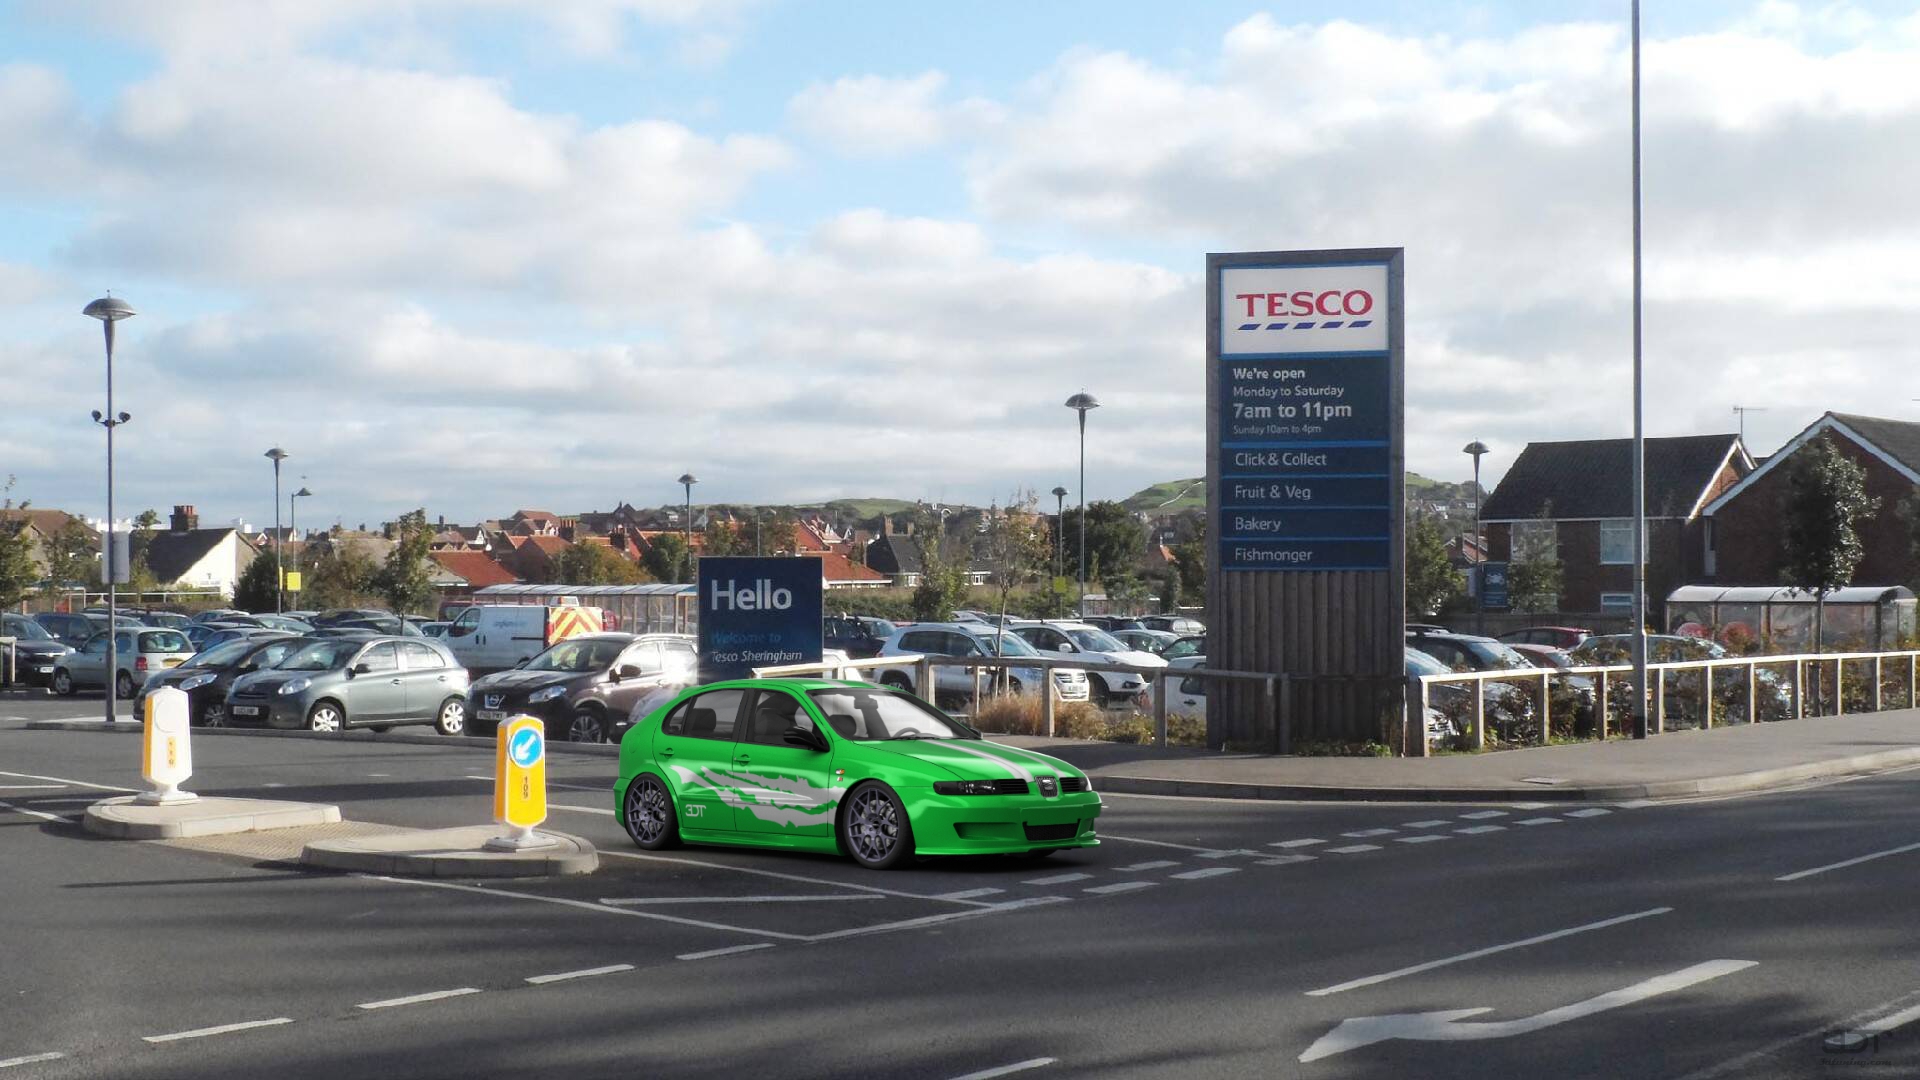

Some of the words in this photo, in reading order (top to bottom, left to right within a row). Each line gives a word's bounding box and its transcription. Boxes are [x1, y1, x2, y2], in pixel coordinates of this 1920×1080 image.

[1236, 290, 1373, 317] TESCO
[1233, 367, 1268, 379] We're
[1273, 368, 1306, 382] open
[1233, 386, 1278, 398] Monday
[1280, 387, 1291, 396] to
[1294, 384, 1344, 397] Saturday
[1233, 403, 1271, 419] 7am
[1278, 404, 1296, 418] to
[1302, 402, 1352, 421] 11pm
[1233, 424, 1264, 435] Sunday
[1266, 424, 1290, 434] 10am
[1291, 425, 1300, 433] to
[1302, 425, 1322, 435] 4pm
[1235, 452, 1266, 466] Click
[1268, 453, 1279, 466] &
[1282, 452, 1327, 466] Collect
[1235, 484, 1265, 499] Fruit
[1269, 485, 1280, 499] &
[1285, 485, 1311, 500] Veg
[1235, 517, 1282, 532] Bakery
[1235, 548, 1313, 563] Fishmonger
[711, 579, 792, 610] Hello
[768, 631, 782, 643] to
[711, 651, 738, 663] Tesco
[741, 650, 803, 664] Sheringham
